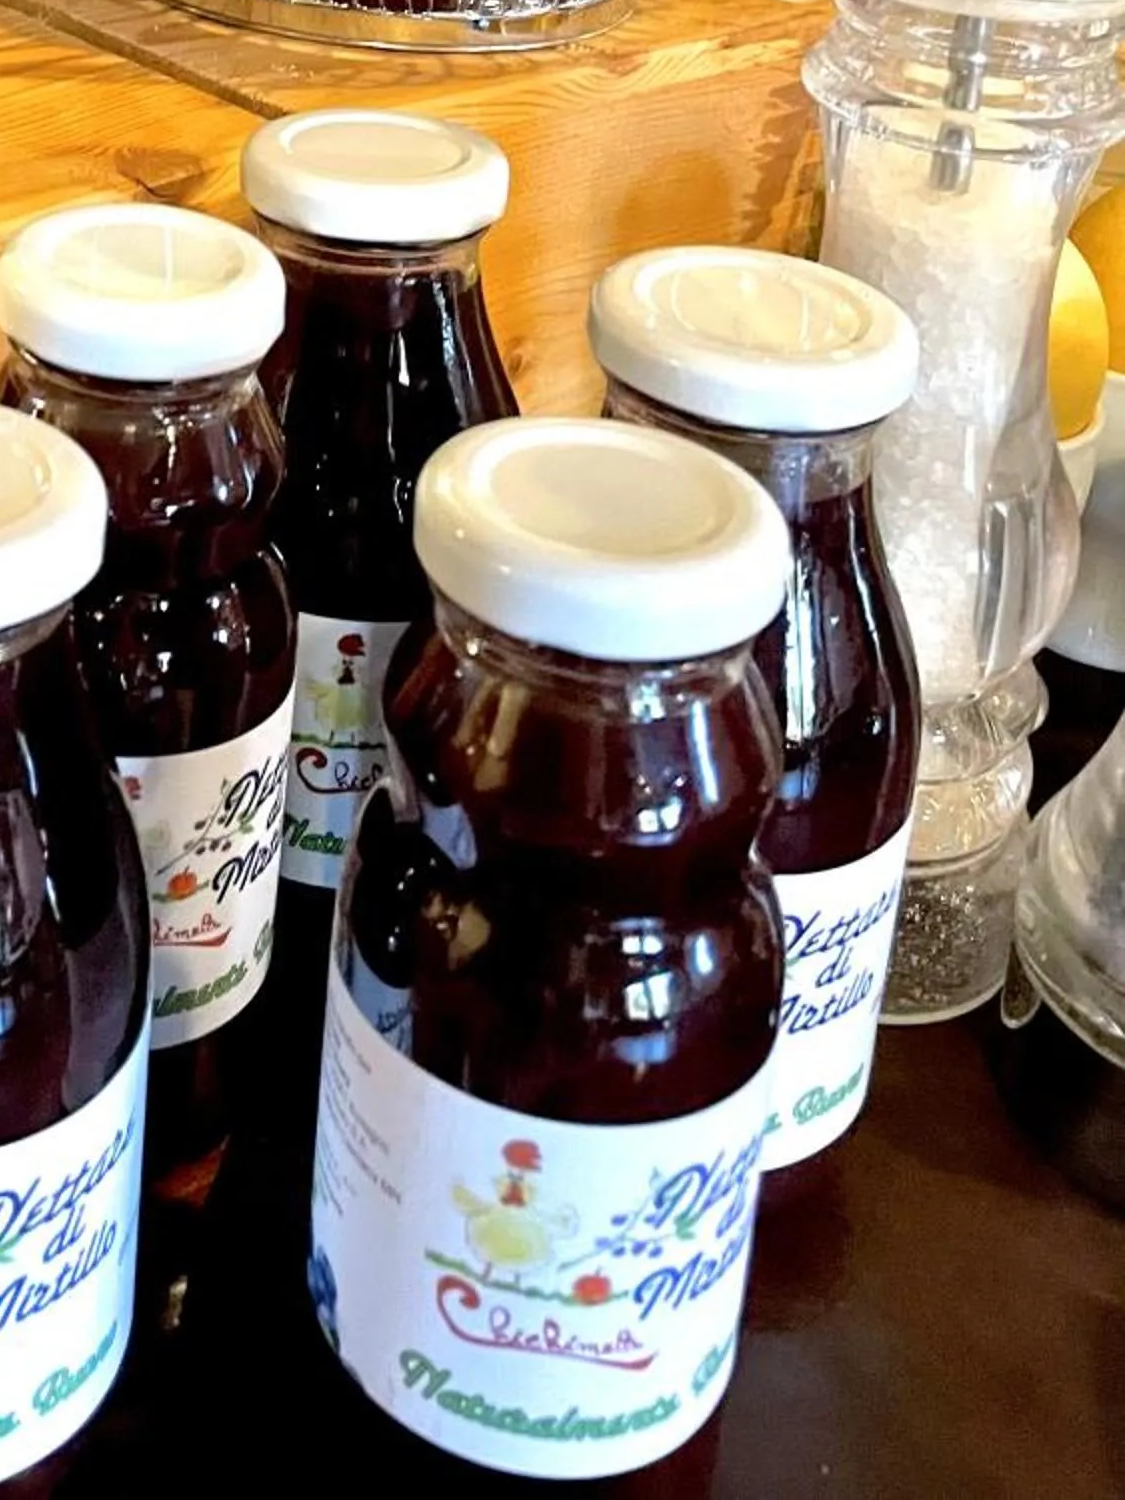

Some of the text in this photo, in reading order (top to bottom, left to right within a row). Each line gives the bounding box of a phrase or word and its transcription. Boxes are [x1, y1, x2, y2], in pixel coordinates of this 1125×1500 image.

[814, 946, 854, 989] di
[44, 1202, 88, 1264] di
[400, 1350, 682, 1443] Naturalmente
